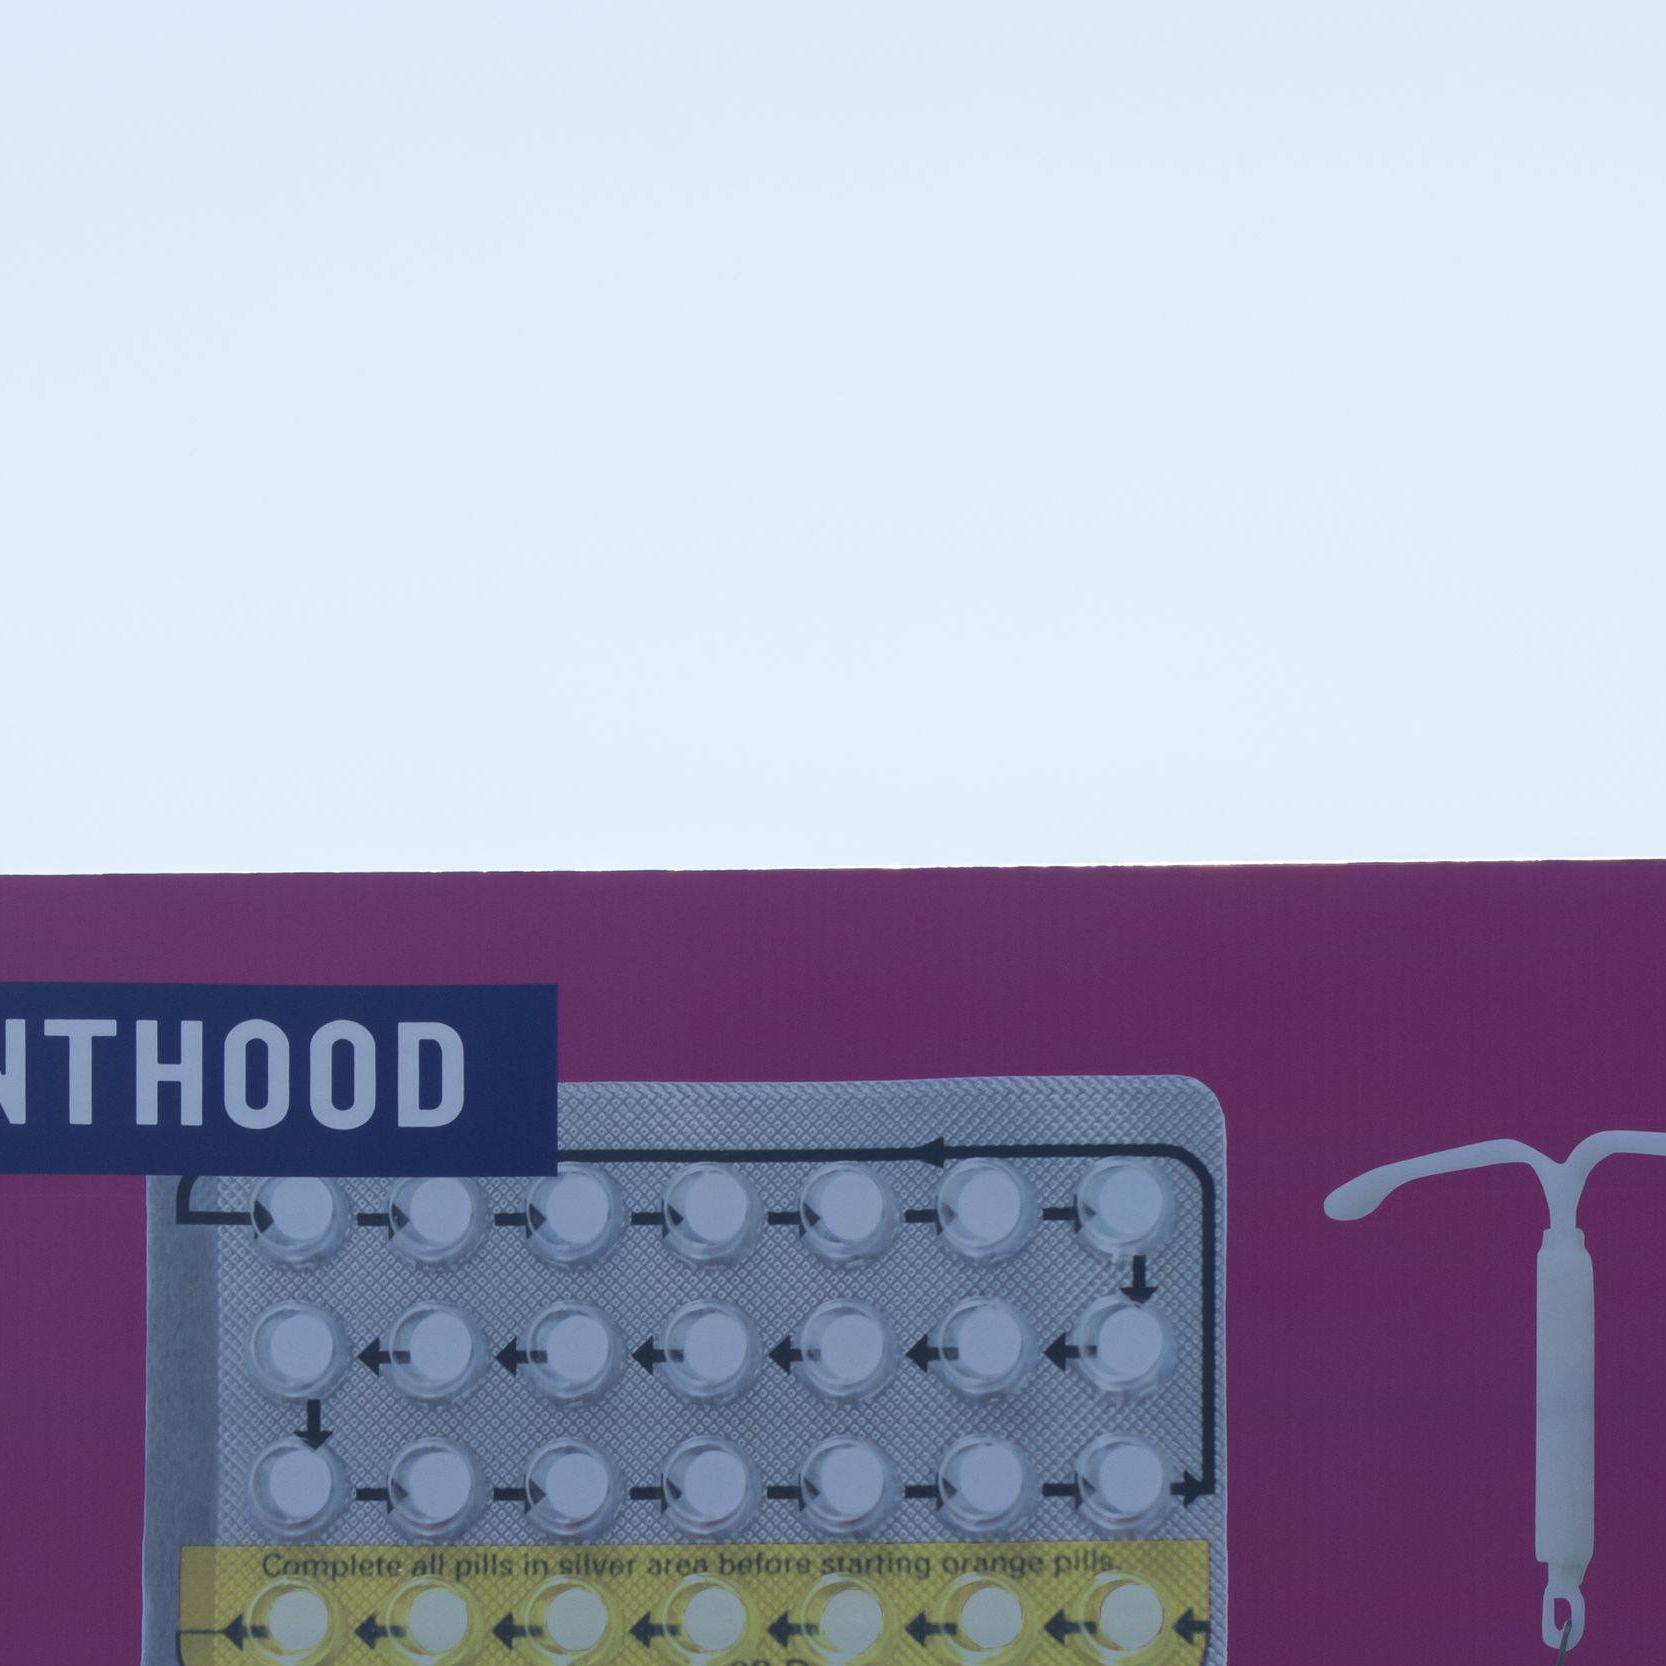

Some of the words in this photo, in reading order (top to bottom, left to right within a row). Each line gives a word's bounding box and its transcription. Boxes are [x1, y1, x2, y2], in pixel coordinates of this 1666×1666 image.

[262, 1553, 402, 1579] Complete
[411, 1553, 444, 1576] all
[455, 1553, 514, 1581] pills
[524, 1553, 549, 1576] in
[559, 1552, 635, 1577] silver
[647, 1557, 709, 1576] area
[719, 1551, 812, 1576] before
[821, 1552, 931, 1578] starting
[942, 1556, 1044, 1579] orange
